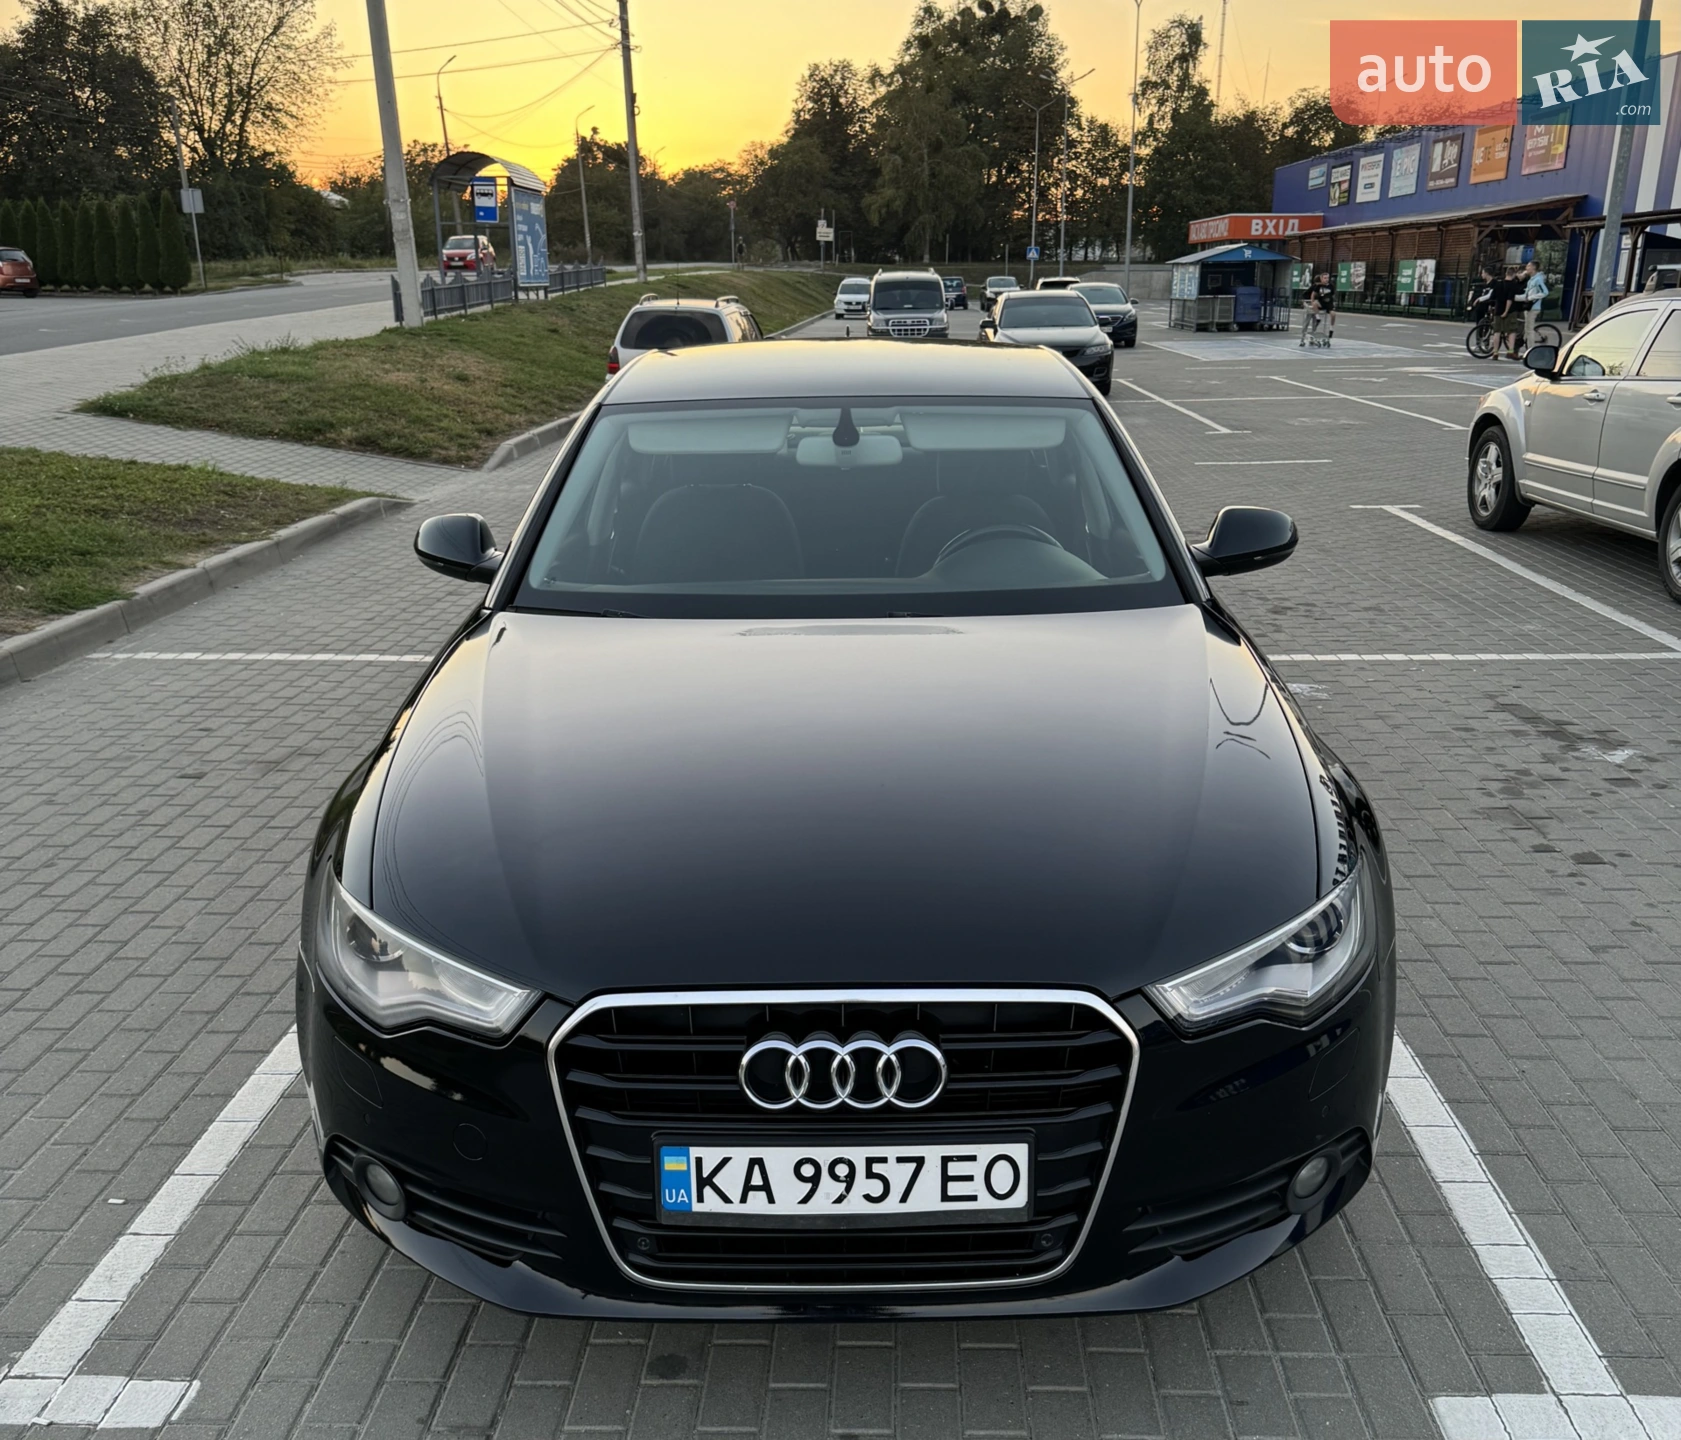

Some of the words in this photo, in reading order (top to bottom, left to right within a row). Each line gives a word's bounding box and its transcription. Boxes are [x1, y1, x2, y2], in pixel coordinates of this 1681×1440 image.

[1250, 218, 1300, 237] ВХІД
[694, 1156, 776, 1205] KA
[793, 1155, 926, 1205] 9957
[940, 1153, 1021, 1203] EO
[665, 1188, 690, 1204] UA
